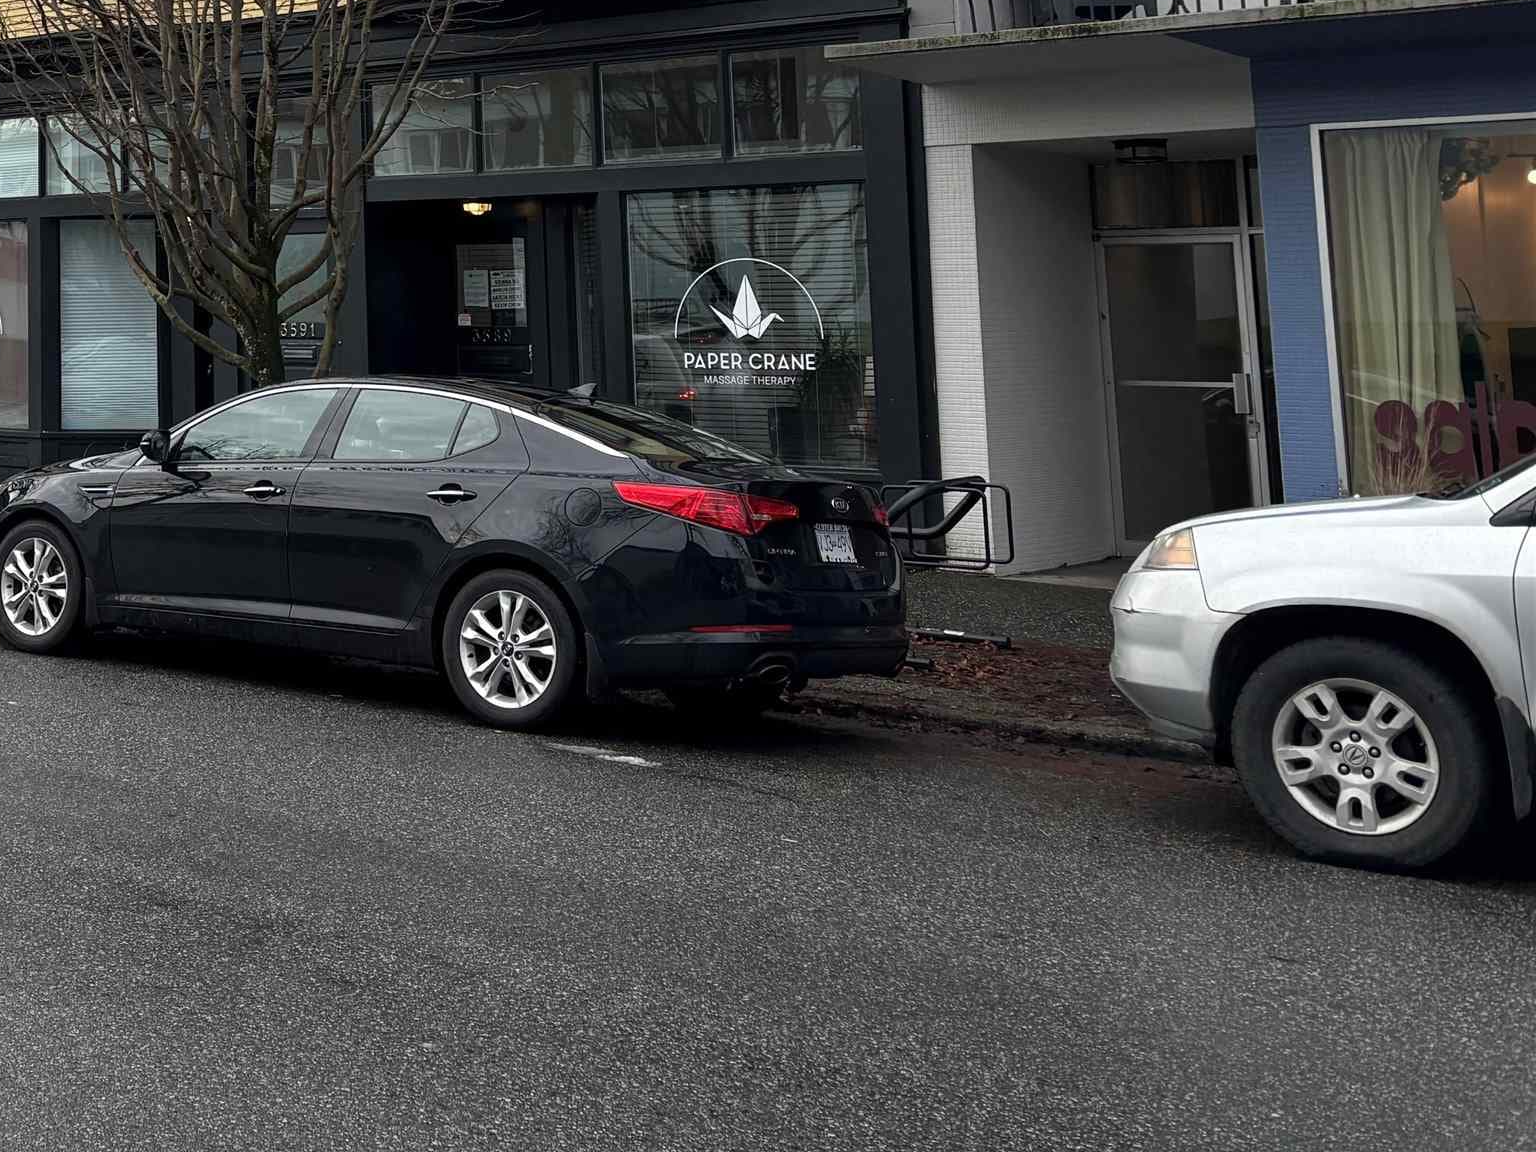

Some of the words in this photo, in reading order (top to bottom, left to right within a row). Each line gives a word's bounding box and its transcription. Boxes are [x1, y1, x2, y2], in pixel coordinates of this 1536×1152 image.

[280, 322, 315, 337] 3591
[684, 352, 743, 370] PAPER
[748, 353, 817, 371] CRANE
[703, 375, 750, 385] MASSAGE
[751, 375, 797, 386] THERAPY
